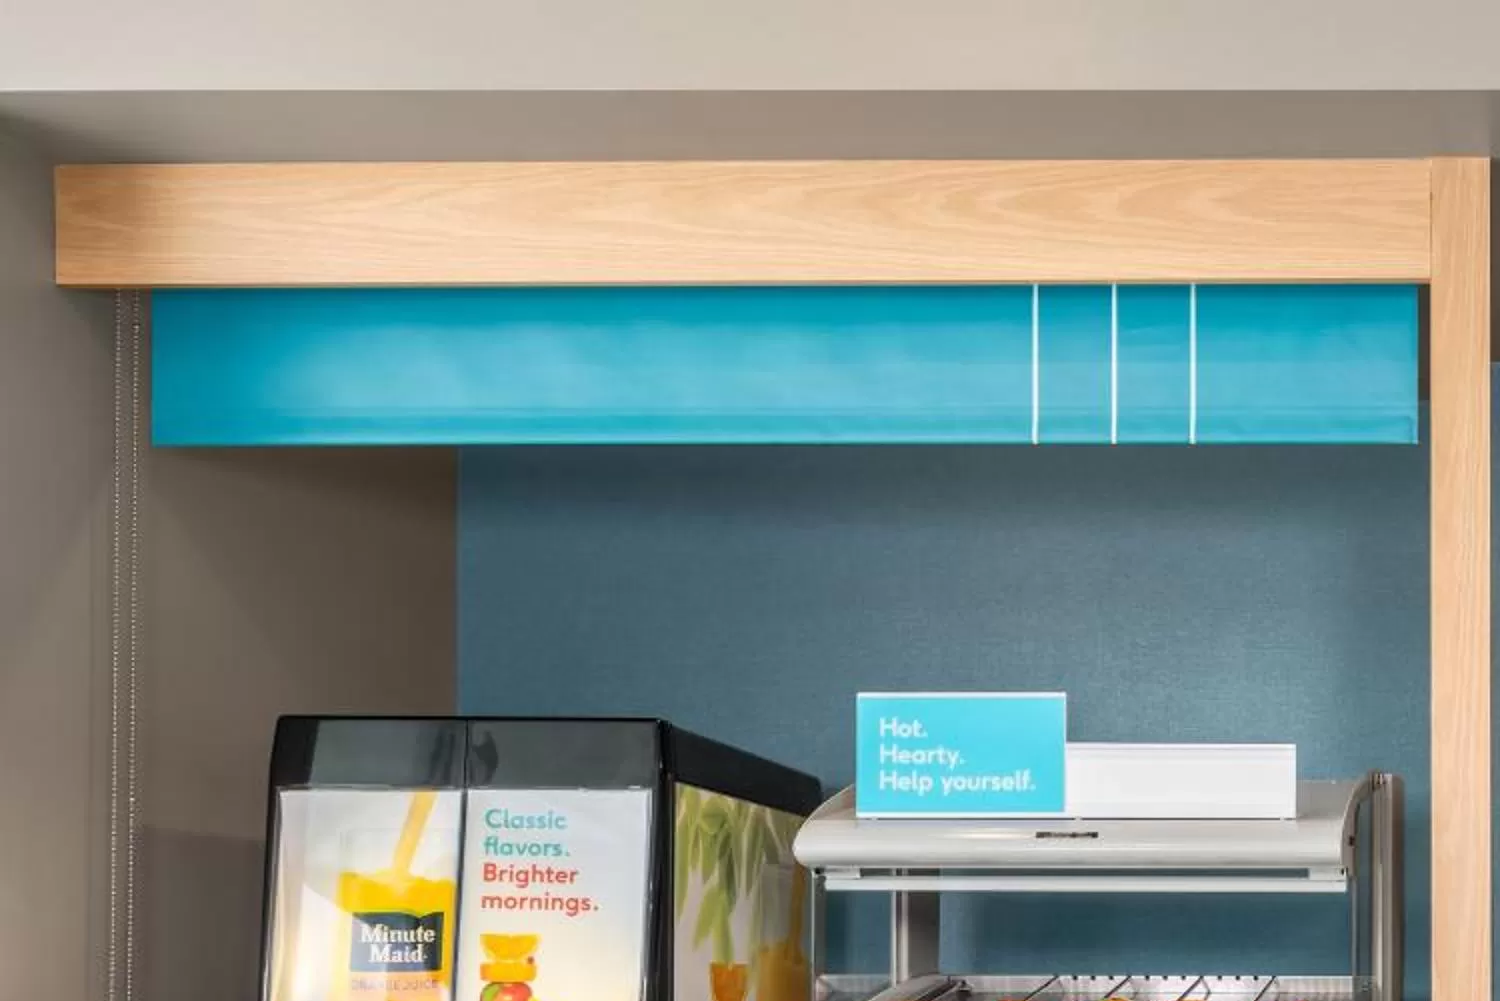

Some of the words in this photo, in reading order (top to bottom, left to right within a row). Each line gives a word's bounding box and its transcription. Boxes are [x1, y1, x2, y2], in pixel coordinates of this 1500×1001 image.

[879, 717, 928, 738] Hot.
[879, 744, 966, 771] Hearty.
[879, 770, 933, 797] Help
[940, 770, 1037, 796] yourself.
[484, 808, 568, 830] Classic
[484, 835, 571, 857] flavors.
[483, 862, 579, 889] Brighter
[481, 891, 599, 917] mornings.
[360, 923, 436, 943] Minute
[368, 943, 424, 963] Maid
